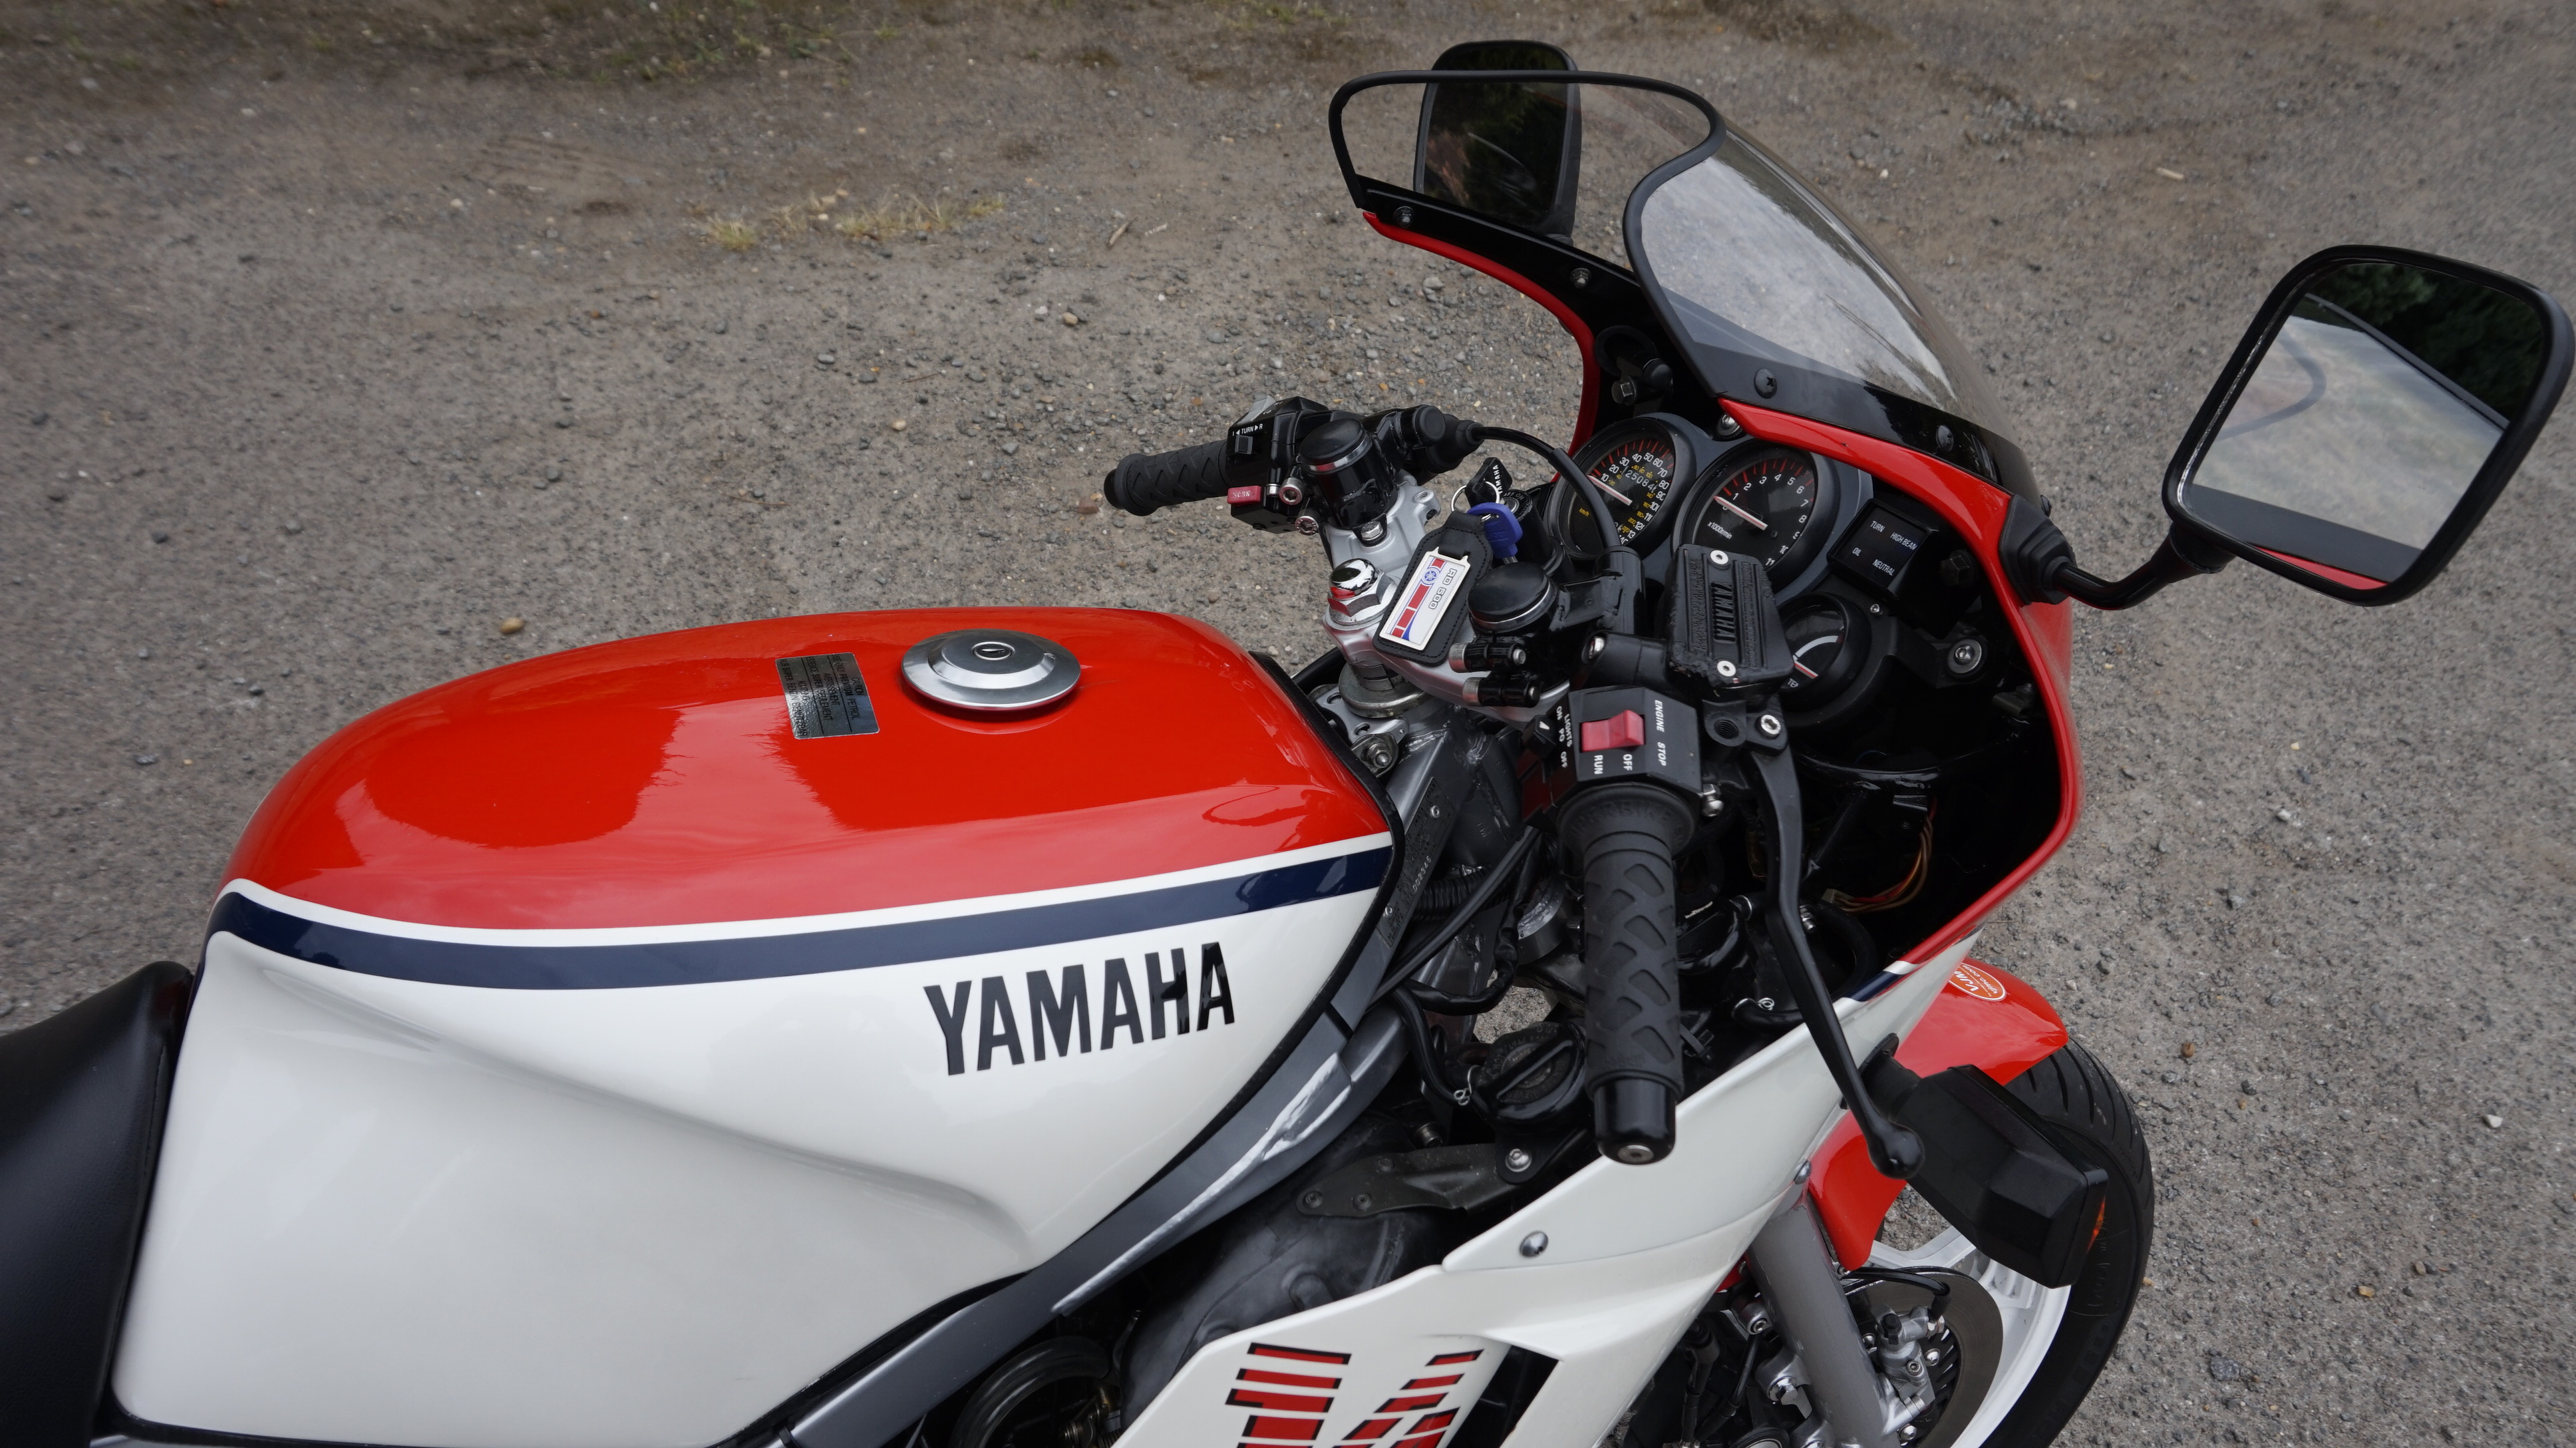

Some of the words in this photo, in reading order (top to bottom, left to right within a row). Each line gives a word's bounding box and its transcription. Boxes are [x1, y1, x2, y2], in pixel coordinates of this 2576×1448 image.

[1619, 457, 1630, 466] 30
[1632, 453, 1642, 462] 40
[1643, 452, 1654, 462] 50
[1653, 458, 1663, 467] 60
[1609, 464, 1619, 474] 20
[1657, 467, 1668, 477] 70
[1493, 464, 1504, 494] YAMAHA
[1600, 473, 1609, 482] 10
[1787, 477, 1796, 486] 5
[1659, 480, 1669, 490] 80
[1743, 482, 1752, 491] 2
[1796, 486, 1805, 494] 6
[1798, 514, 1808, 524] 8
[1870, 520, 1885, 532] TURN
[1890, 532, 1904, 544] HIGH
[1852, 547, 1862, 556] OIL
[1765, 558, 1776, 566] 11
[1872, 559, 1895, 576] NEUTRAL
[1442, 568, 1458, 586] RD
[1428, 586, 1447, 610] 500
[1712, 580, 1735, 642] YAMAHA
[783, 667, 794, 681] SUPER
[806, 656, 818, 673] ESSENCE
[812, 673, 824, 688] SUPER
[818, 689, 833, 721] SEULEMENT
[824, 673, 840, 706] AVERTISSEMENT
[852, 677, 866, 695] CAUTION
[840, 673, 853, 696] PREMIUM
[847, 699, 860, 719] PETROL
[1556, 705, 1563, 720] ON
[1655, 699, 1665, 733] ENGINE
[1558, 727, 1565, 742] PO
[1563, 713, 1573, 747] LIGHTS
[1657, 741, 1667, 766] STOP
[1593, 754, 1603, 775] RUN
[1623, 753, 1633, 771] OFF
[923, 942, 1235, 1076] YAMAHA
